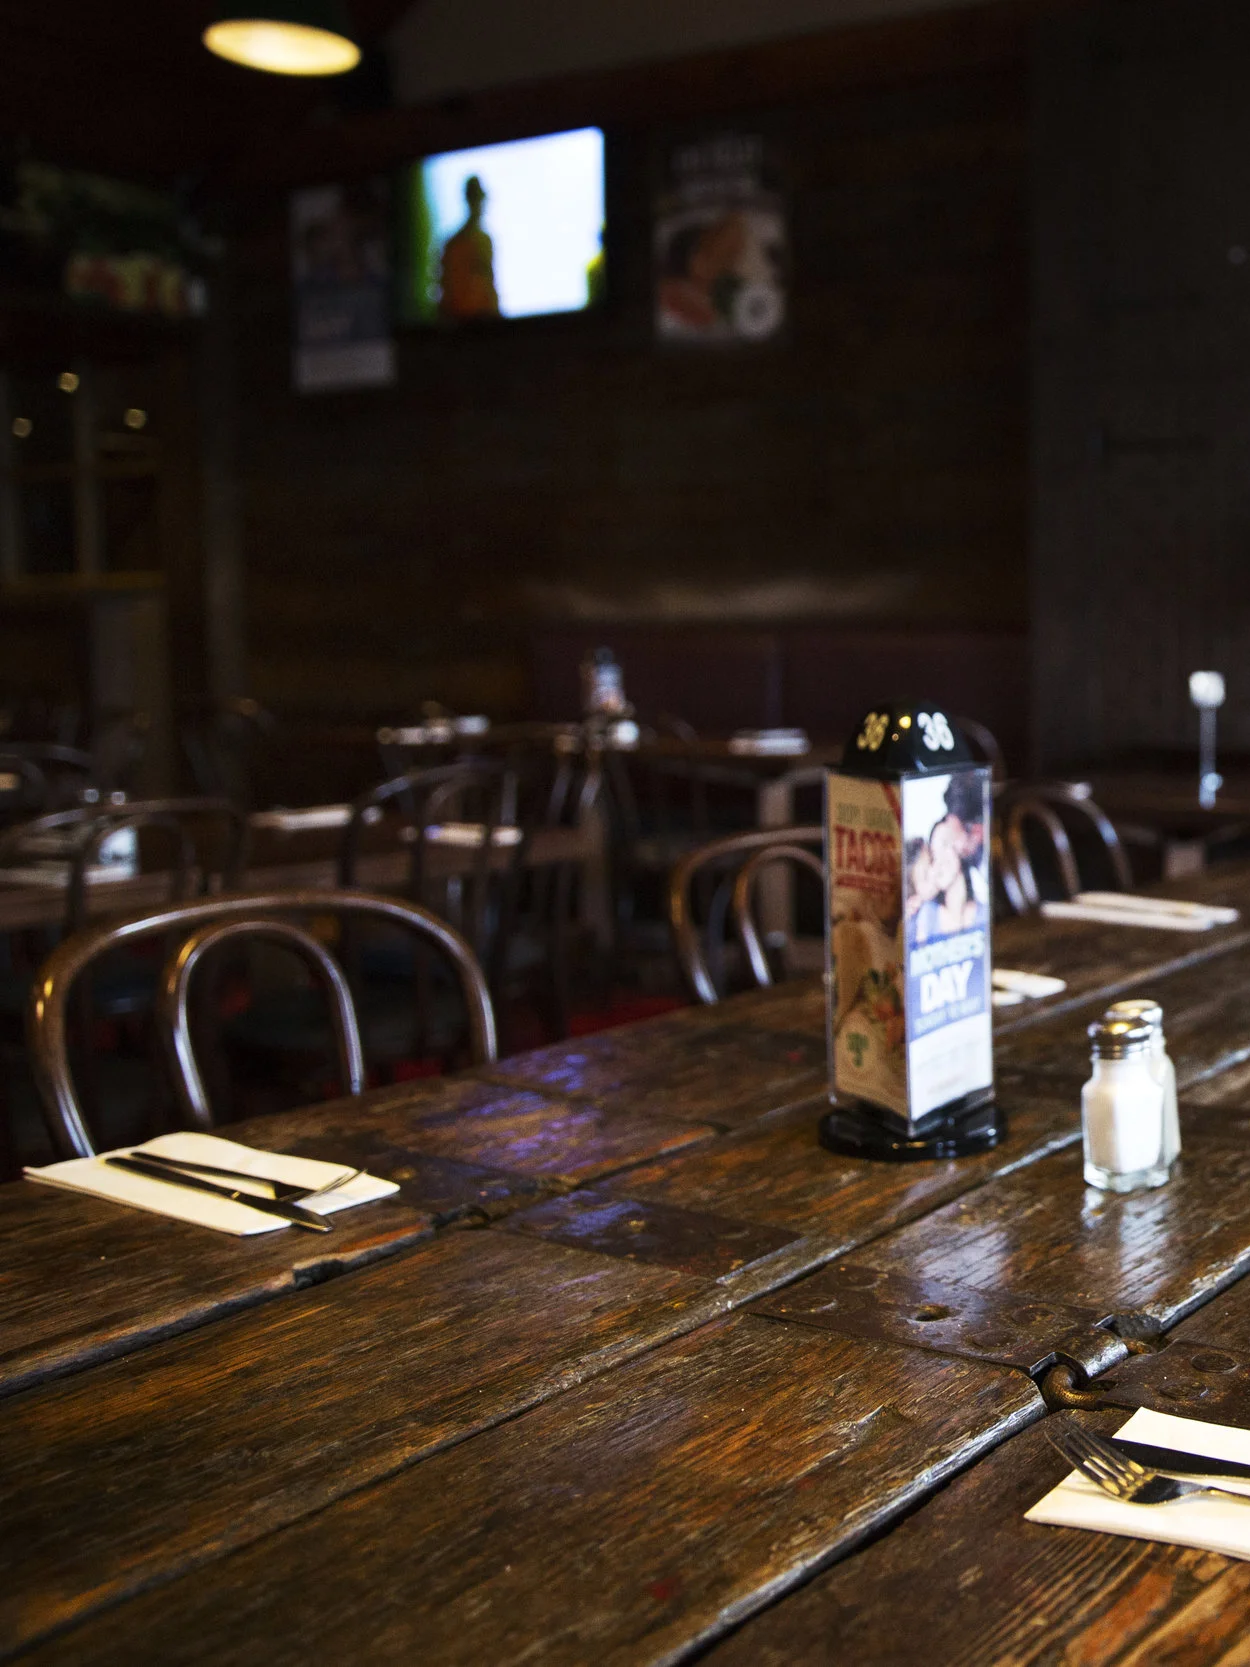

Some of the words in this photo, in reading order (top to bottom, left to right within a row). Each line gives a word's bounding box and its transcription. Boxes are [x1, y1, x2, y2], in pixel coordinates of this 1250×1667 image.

[917, 711, 955, 751] 36
[834, 823, 897, 876] TACOS
[919, 959, 974, 1014] DAY
